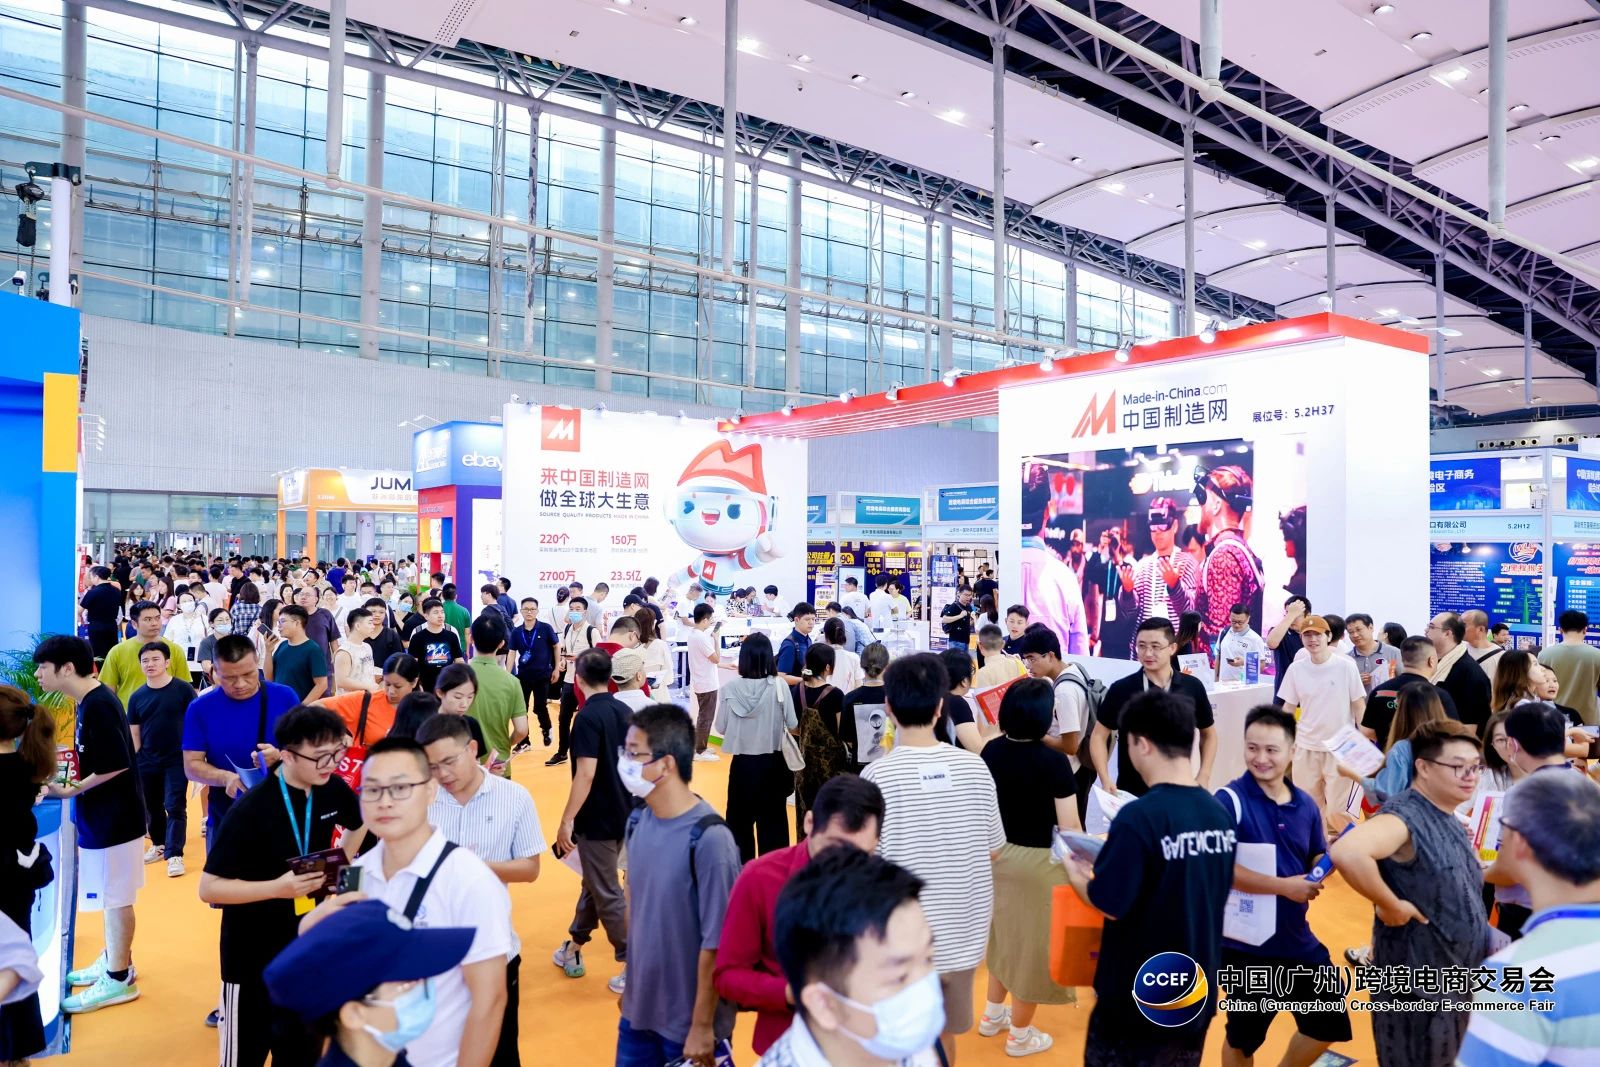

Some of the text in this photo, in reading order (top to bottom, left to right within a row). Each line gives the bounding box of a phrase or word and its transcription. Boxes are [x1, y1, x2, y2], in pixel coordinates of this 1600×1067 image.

[1123, 384, 1228, 405] Made-in-China.com
[1123, 399, 1228, 431] 中国制造网
[540, 468, 649, 489] 来中国制造网
[540, 489, 650, 511] 做全球大生意
[540, 533, 570, 545] 220个
[610, 534, 637, 546] 150万
[539, 571, 576, 582] 2700万
[610, 571, 642, 582] 23.5亿
